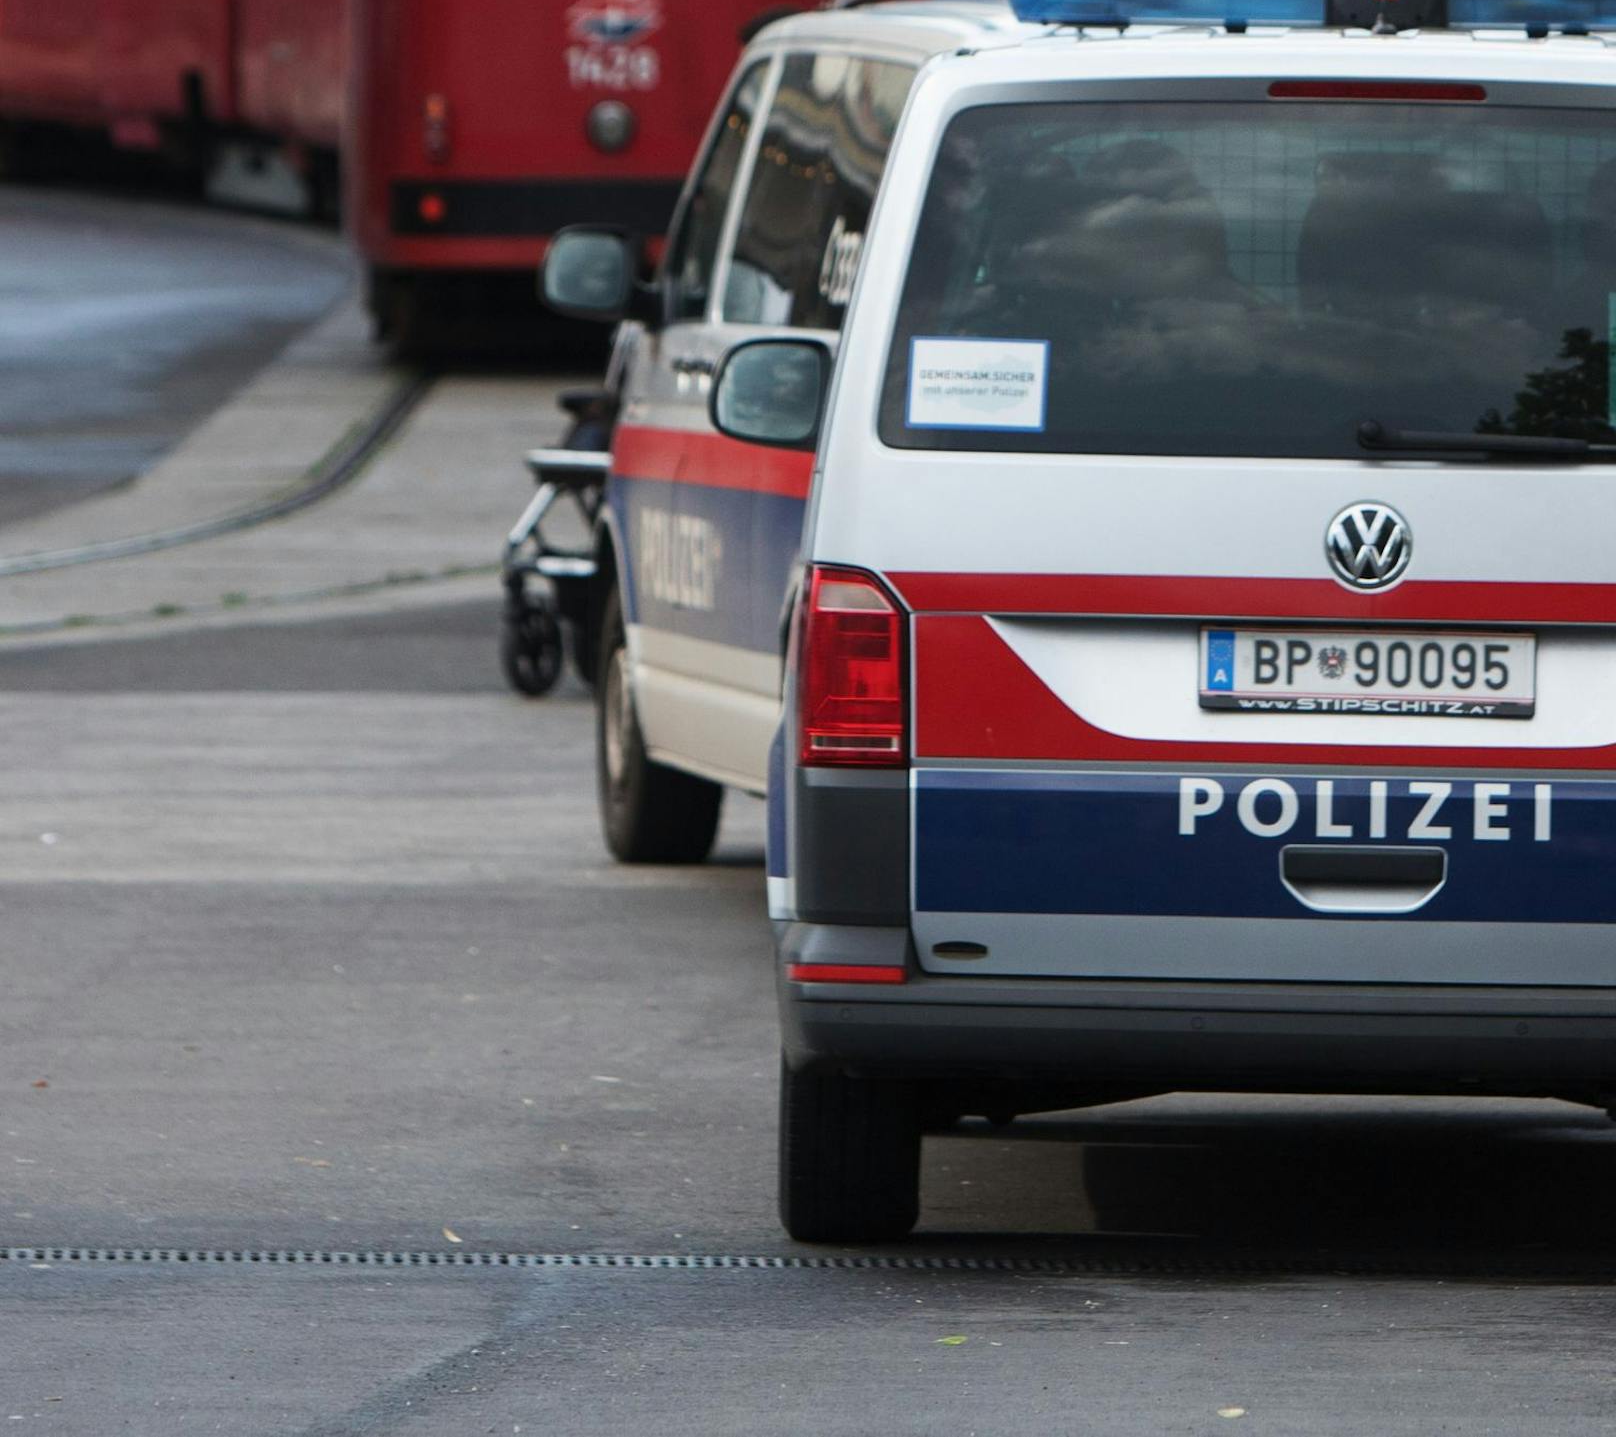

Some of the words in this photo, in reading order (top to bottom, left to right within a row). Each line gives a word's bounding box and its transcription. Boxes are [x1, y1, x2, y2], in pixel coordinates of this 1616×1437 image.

[945, 387, 989, 396] unserer
[991, 386, 1030, 398] Polizei
[1213, 668, 1229, 683] A
[1254, 640, 1313, 685] BP
[1354, 641, 1510, 690] 90095
[1178, 777, 1552, 841] POLIZEI
